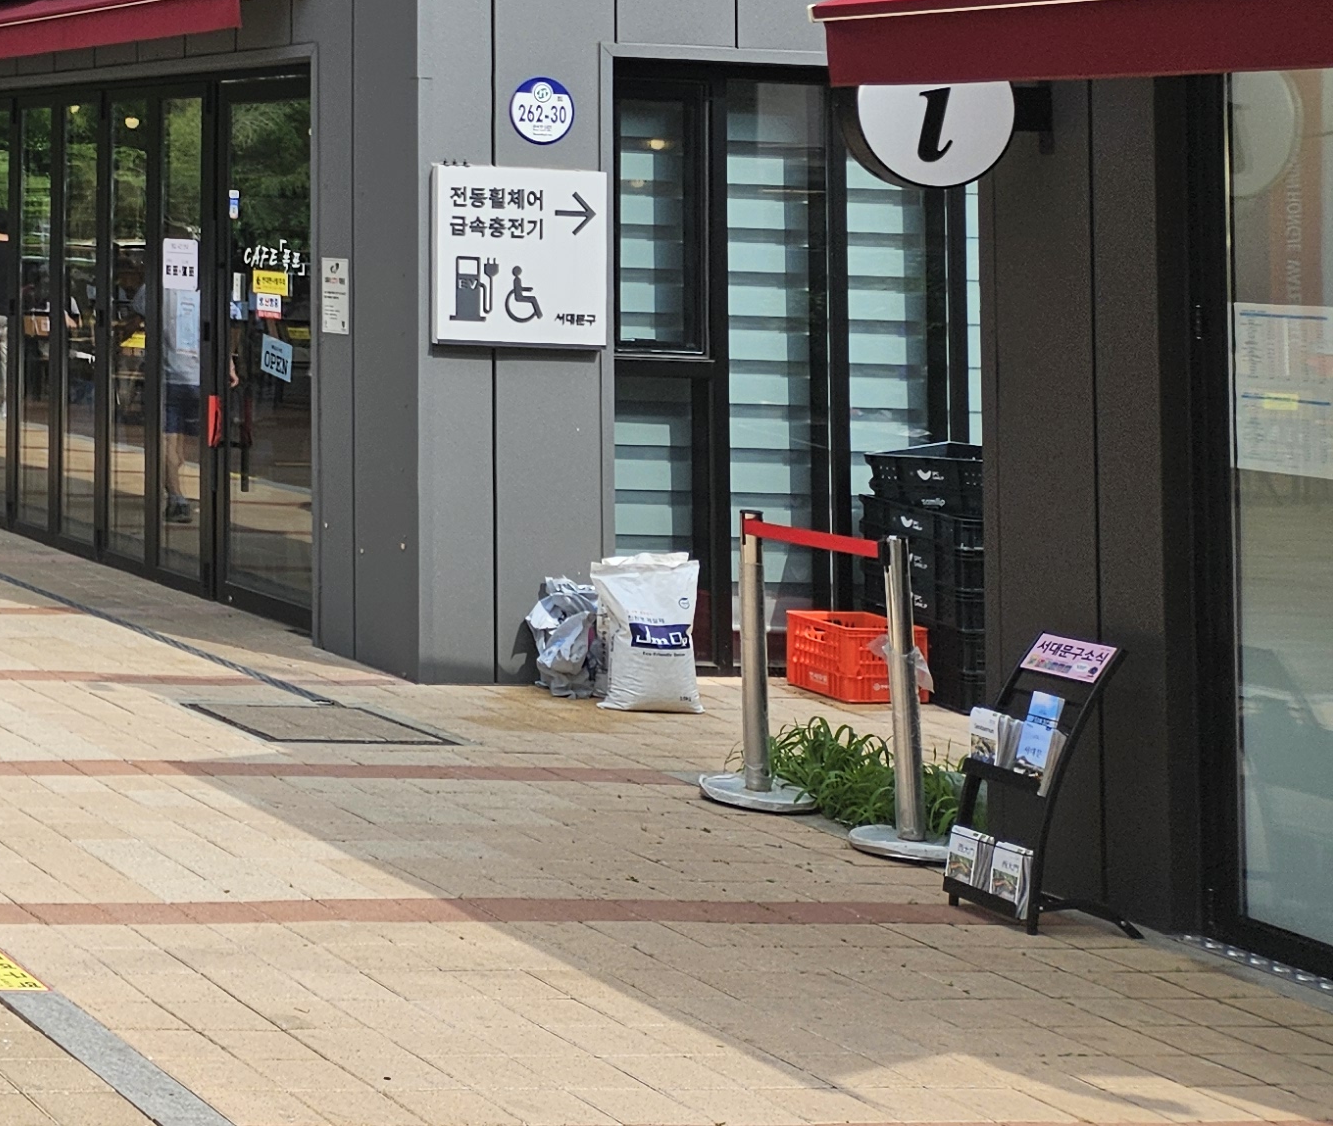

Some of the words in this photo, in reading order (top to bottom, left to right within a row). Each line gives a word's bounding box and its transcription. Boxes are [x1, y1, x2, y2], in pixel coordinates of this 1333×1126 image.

[518, 103, 567, 124] 262-30
[449, 186, 544, 211] 전동휠체어
[449, 215, 544, 240] 급속충전기
[244, 245, 278, 268] CAFE
[458, 278, 478, 290] EV
[264, 350, 289, 375] OPEN
[1037, 641, 1109, 665] 서대문구소식
